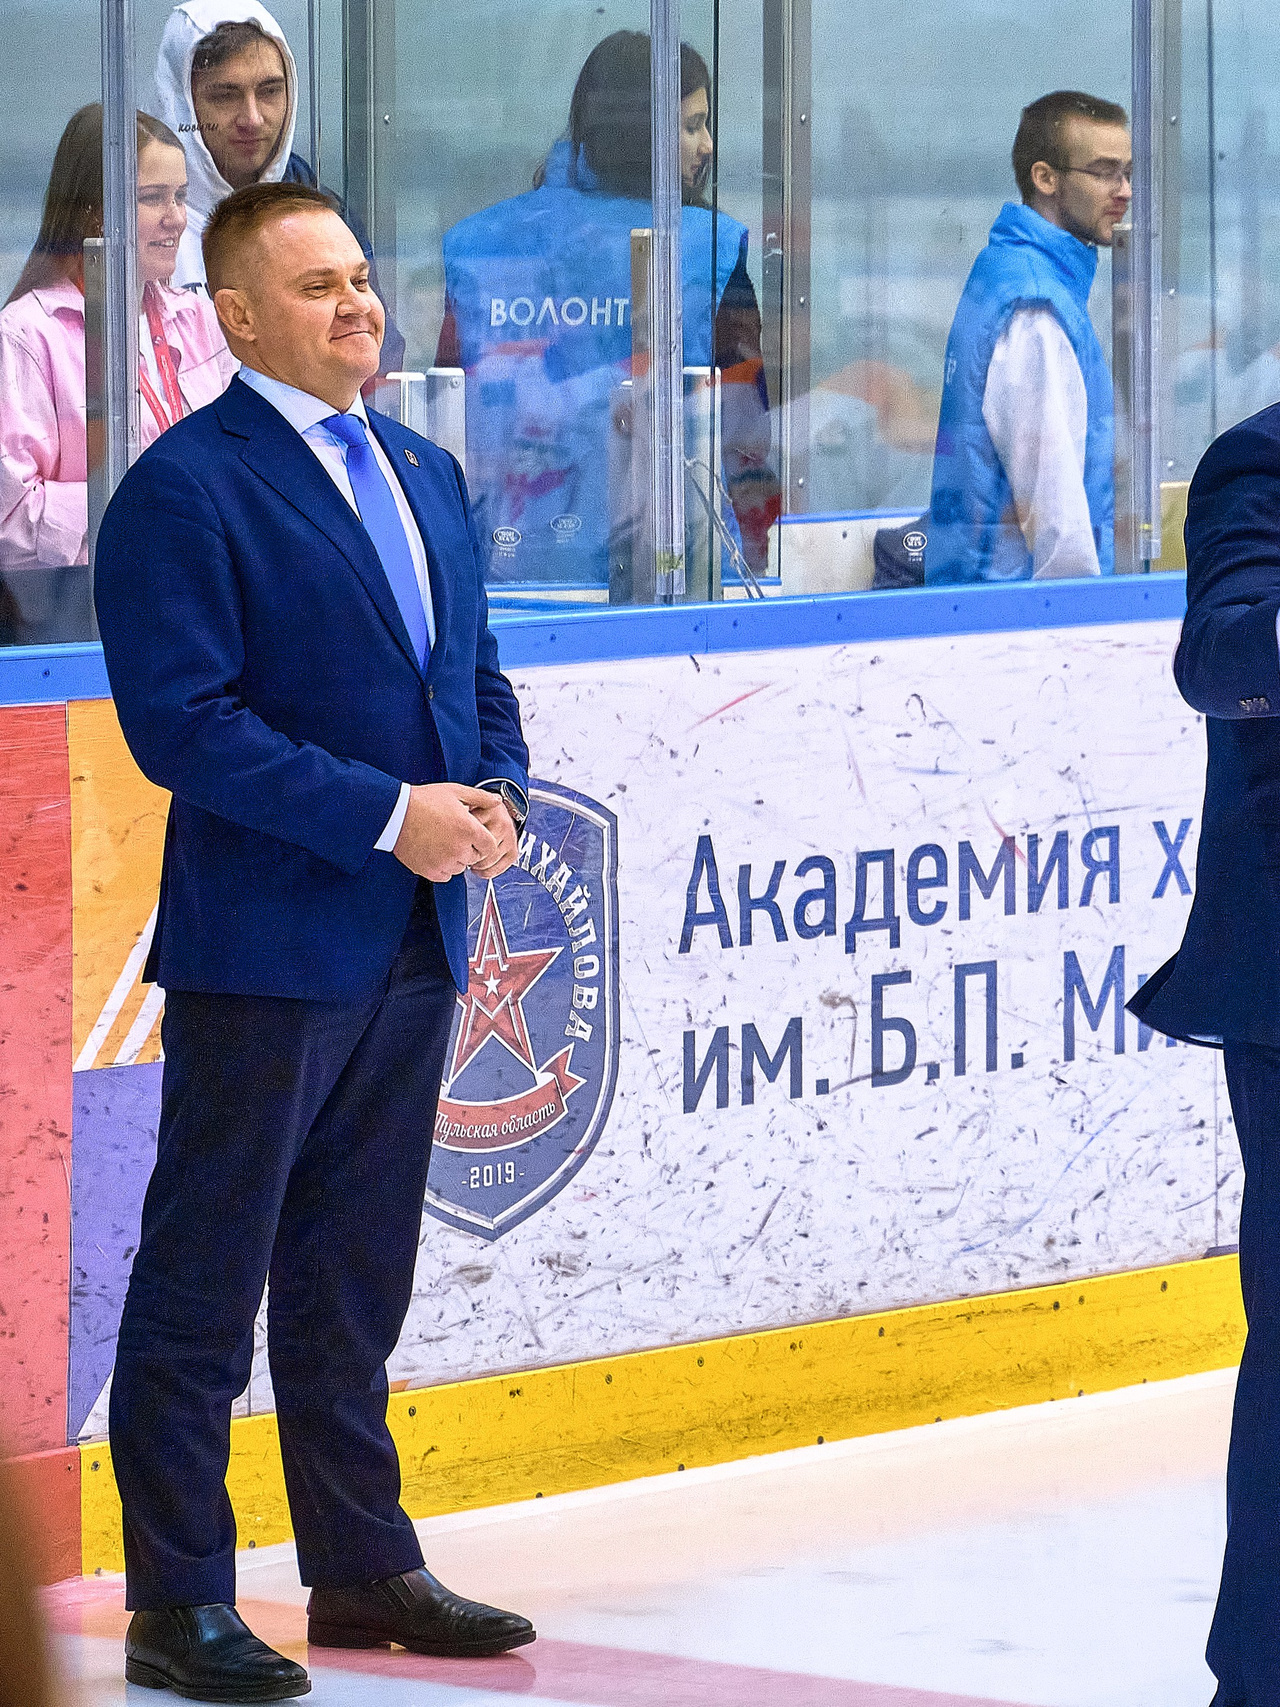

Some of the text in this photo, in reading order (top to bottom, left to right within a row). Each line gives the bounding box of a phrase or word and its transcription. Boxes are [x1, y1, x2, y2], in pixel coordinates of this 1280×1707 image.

[490, 296, 630, 327] ВОЛОНТ
[514, 830, 600, 1043] ИХАЙЛОВА
[678, 825, 1121, 954] Академия
[683, 1016, 830, 1115] им.
[501, 1102, 556, 1135] область
